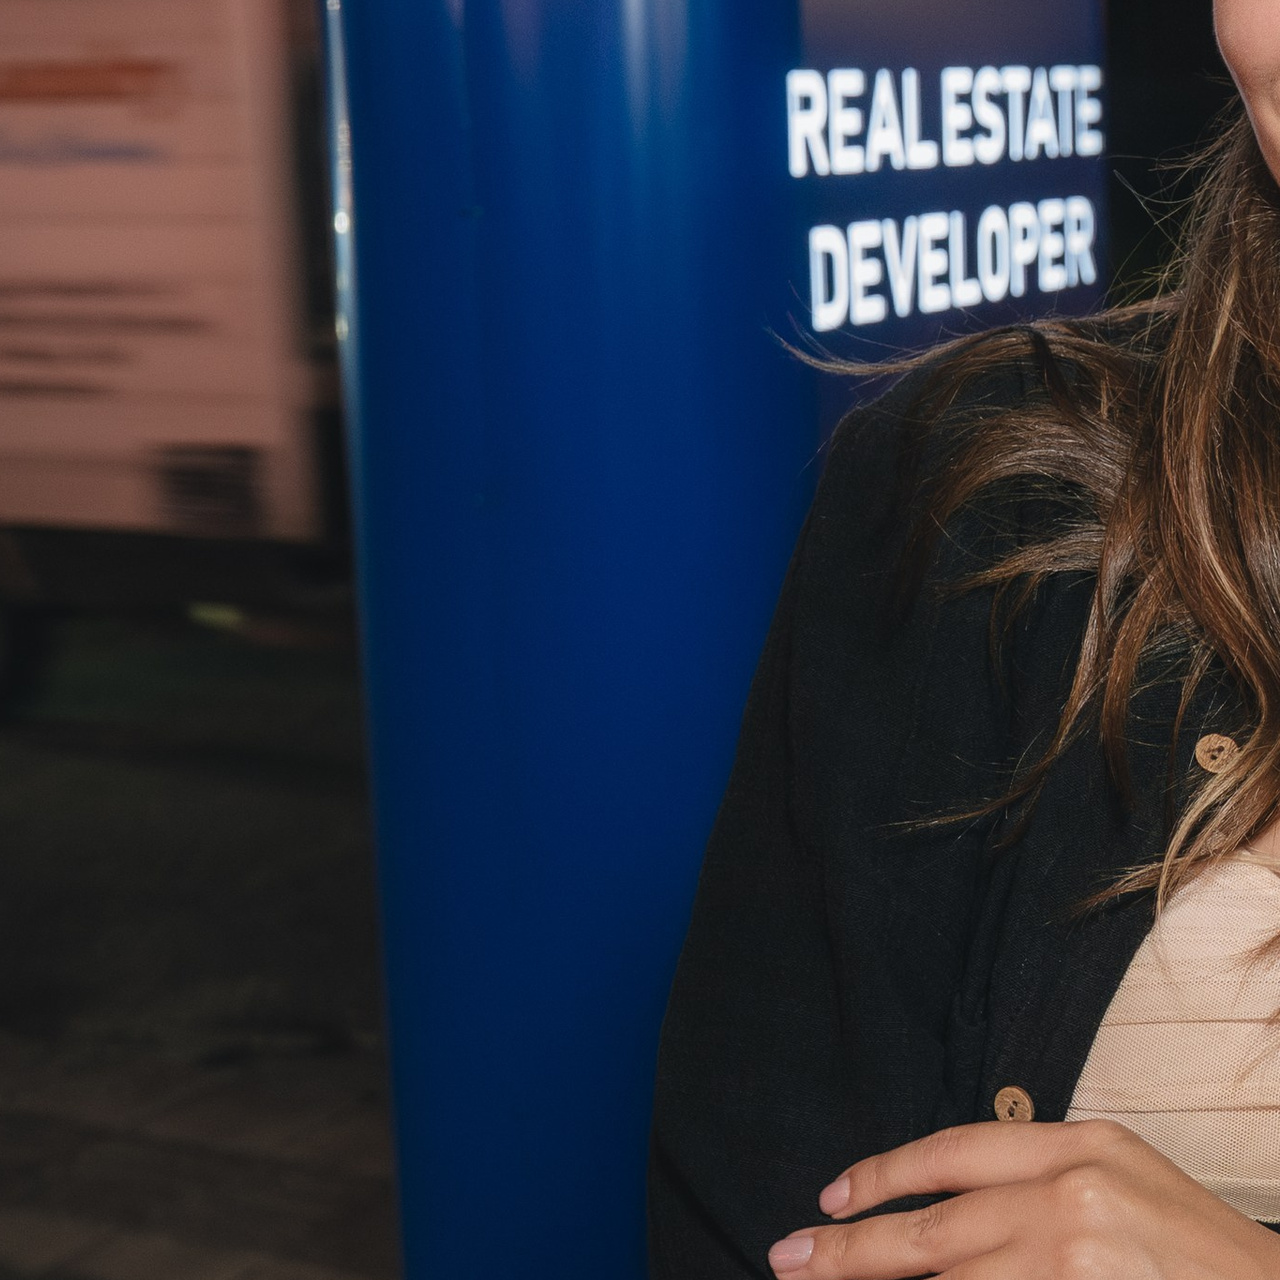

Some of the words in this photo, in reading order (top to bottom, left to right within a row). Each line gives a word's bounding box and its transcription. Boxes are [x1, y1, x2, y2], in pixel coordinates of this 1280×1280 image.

[786, 67, 940, 178] REAL
[940, 64, 1104, 167] ESTATE
[808, 195, 1097, 332] DEVELOPER
